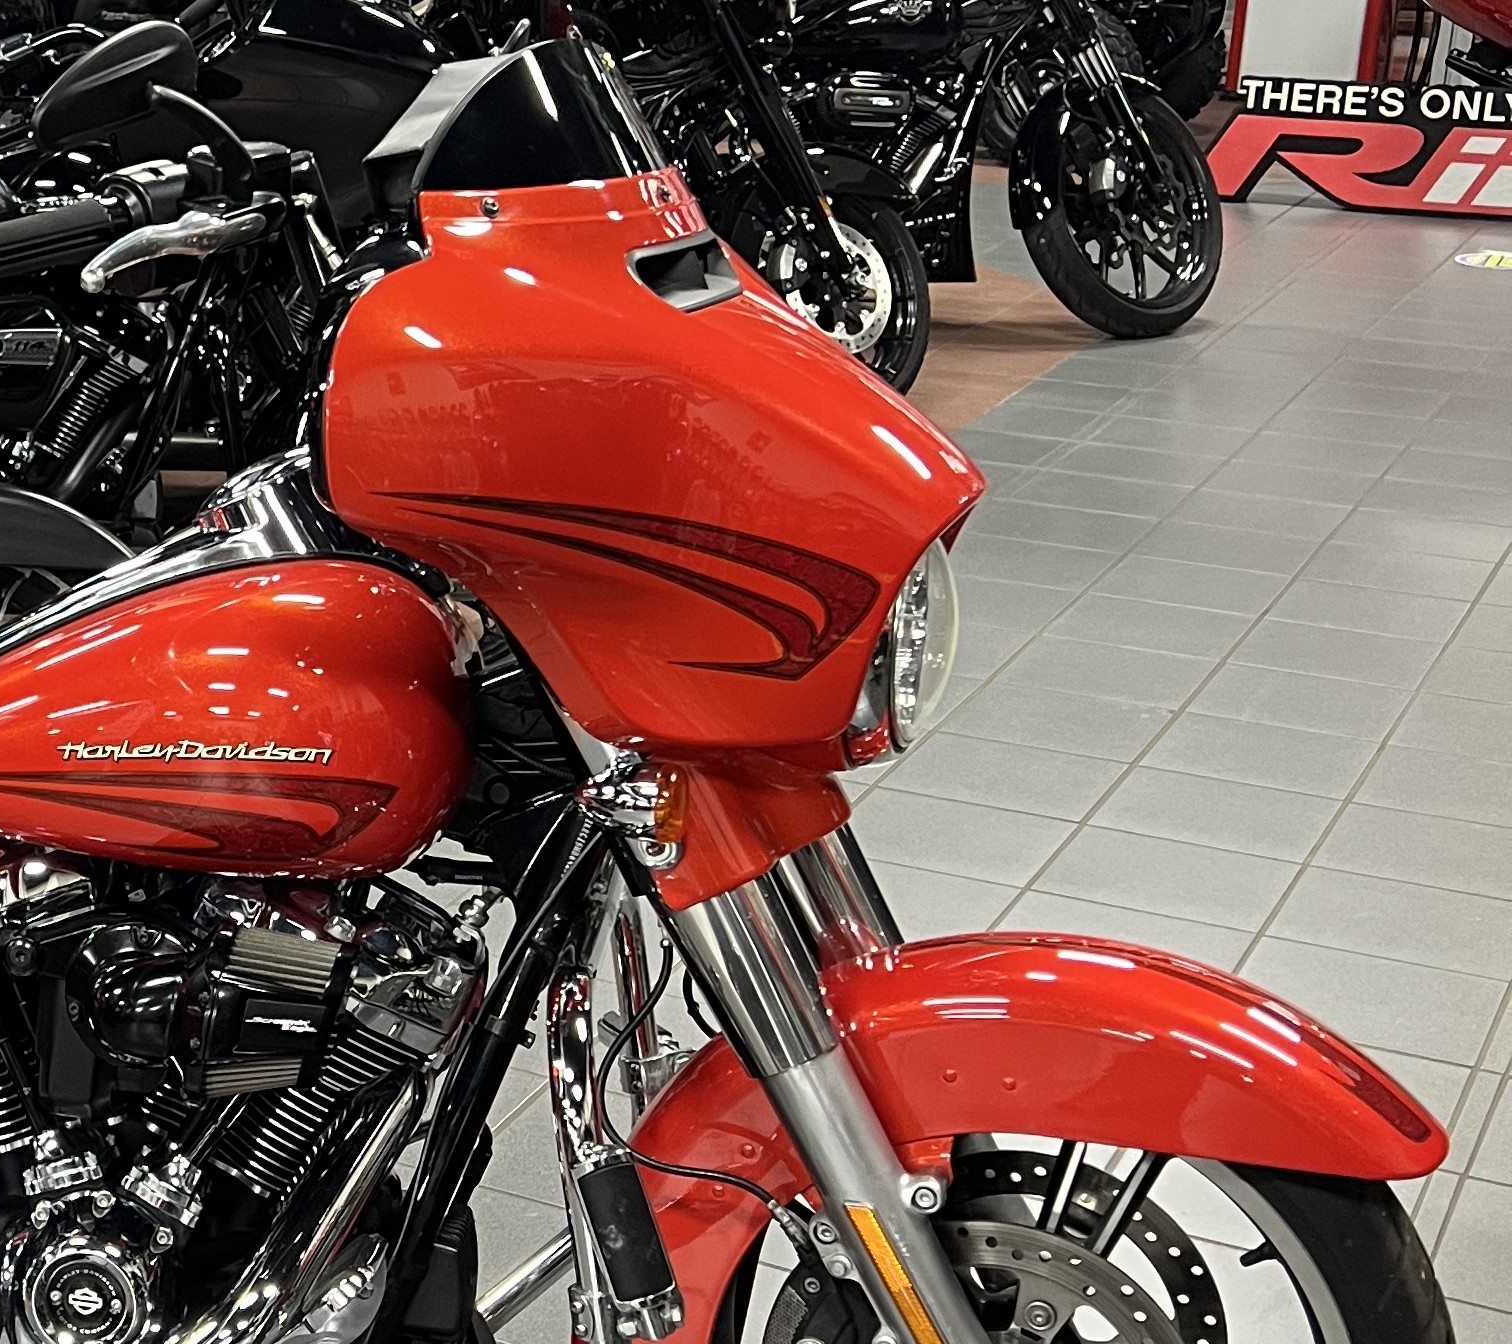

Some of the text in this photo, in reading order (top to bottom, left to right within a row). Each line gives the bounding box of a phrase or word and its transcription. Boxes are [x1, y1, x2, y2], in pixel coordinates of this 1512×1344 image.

[1241, 78, 1512, 123] THERE'S ONL
[56, 739, 334, 765] Harley-Davidson
